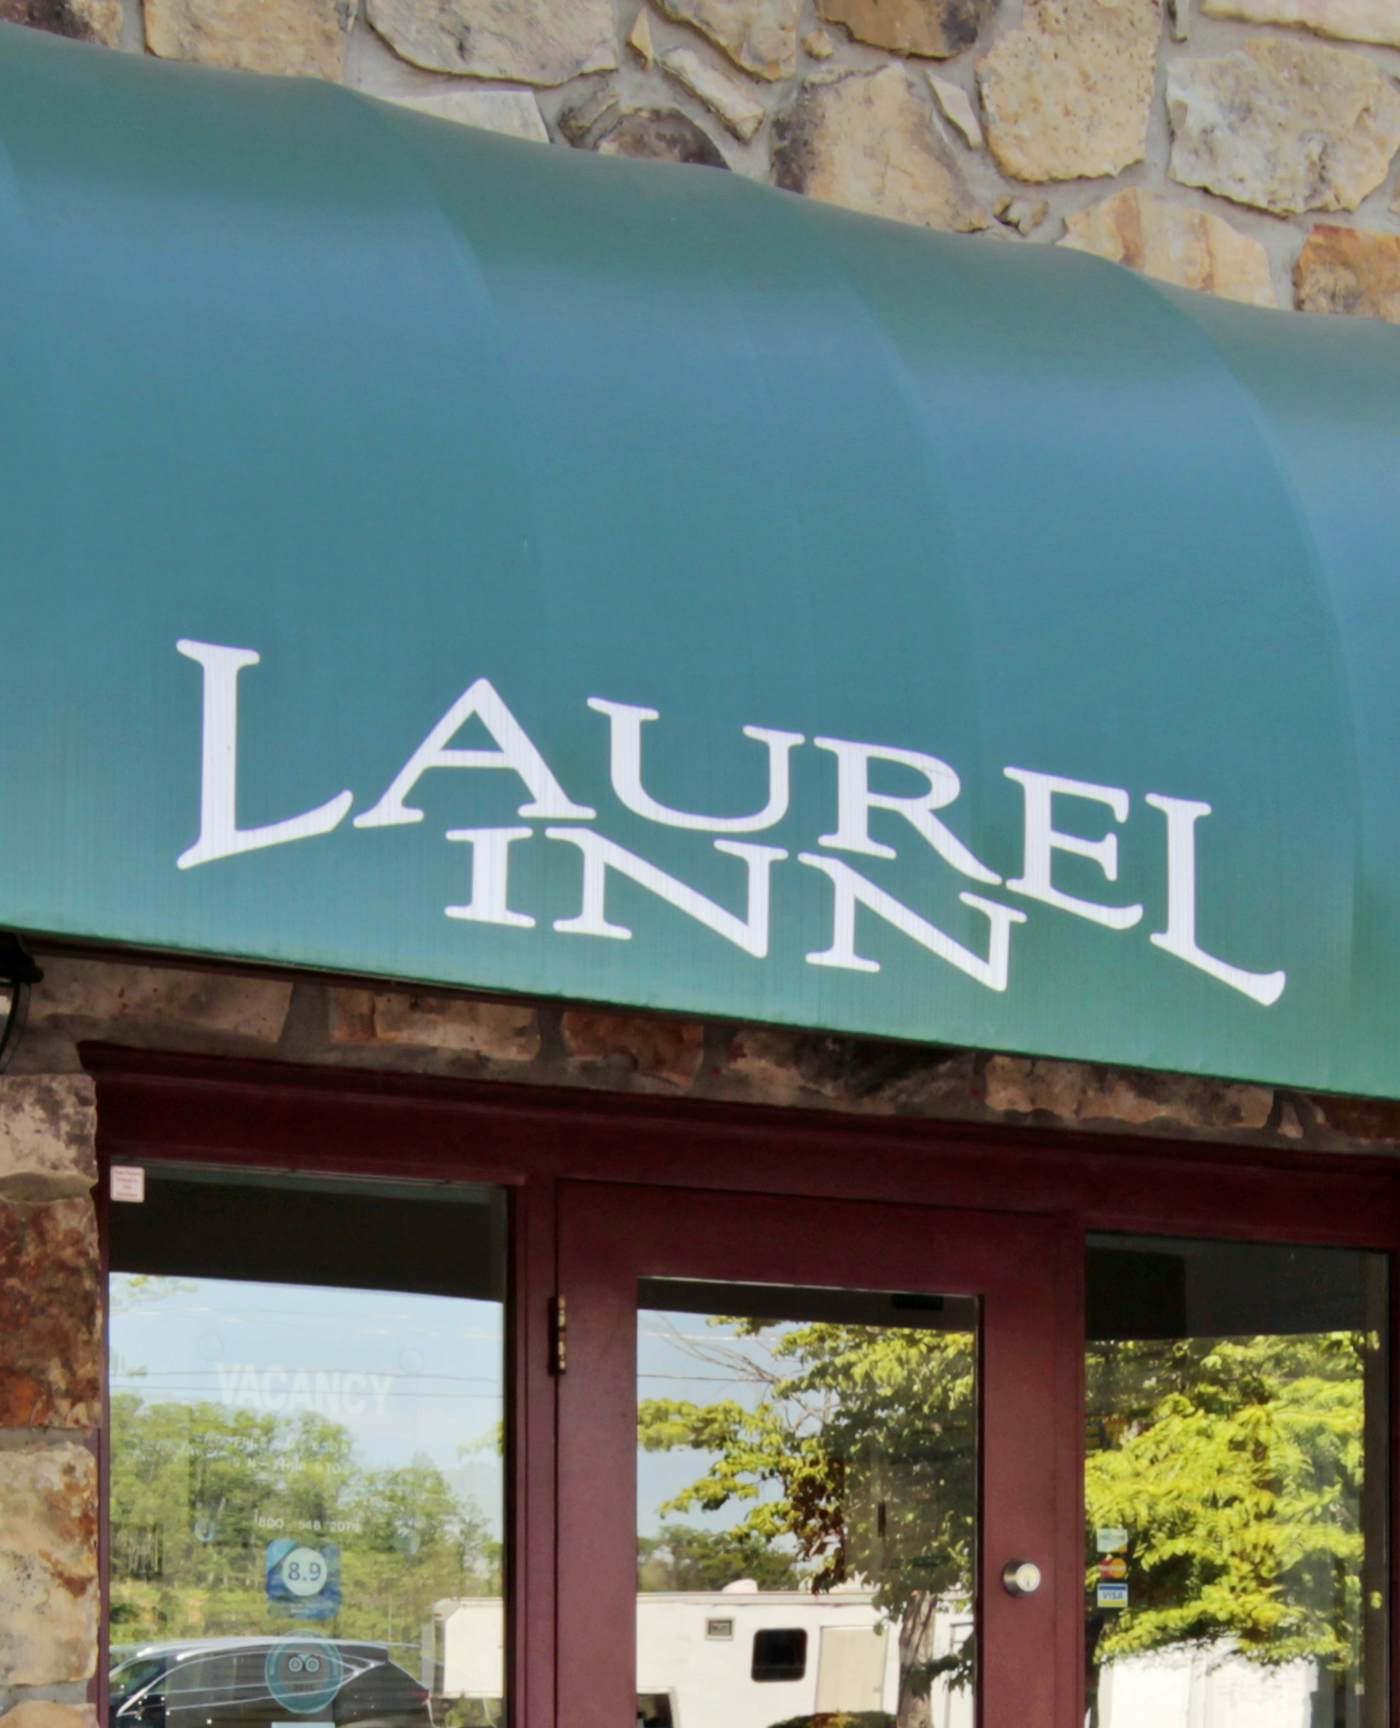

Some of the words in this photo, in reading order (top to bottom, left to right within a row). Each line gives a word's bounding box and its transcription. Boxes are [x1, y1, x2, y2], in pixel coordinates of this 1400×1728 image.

[175, 638, 1287, 1007] LAUREL
[443, 827, 1028, 993] INN
[216, 1363, 393, 1417] VACANCY
[287, 1561, 321, 1582] 8.9
